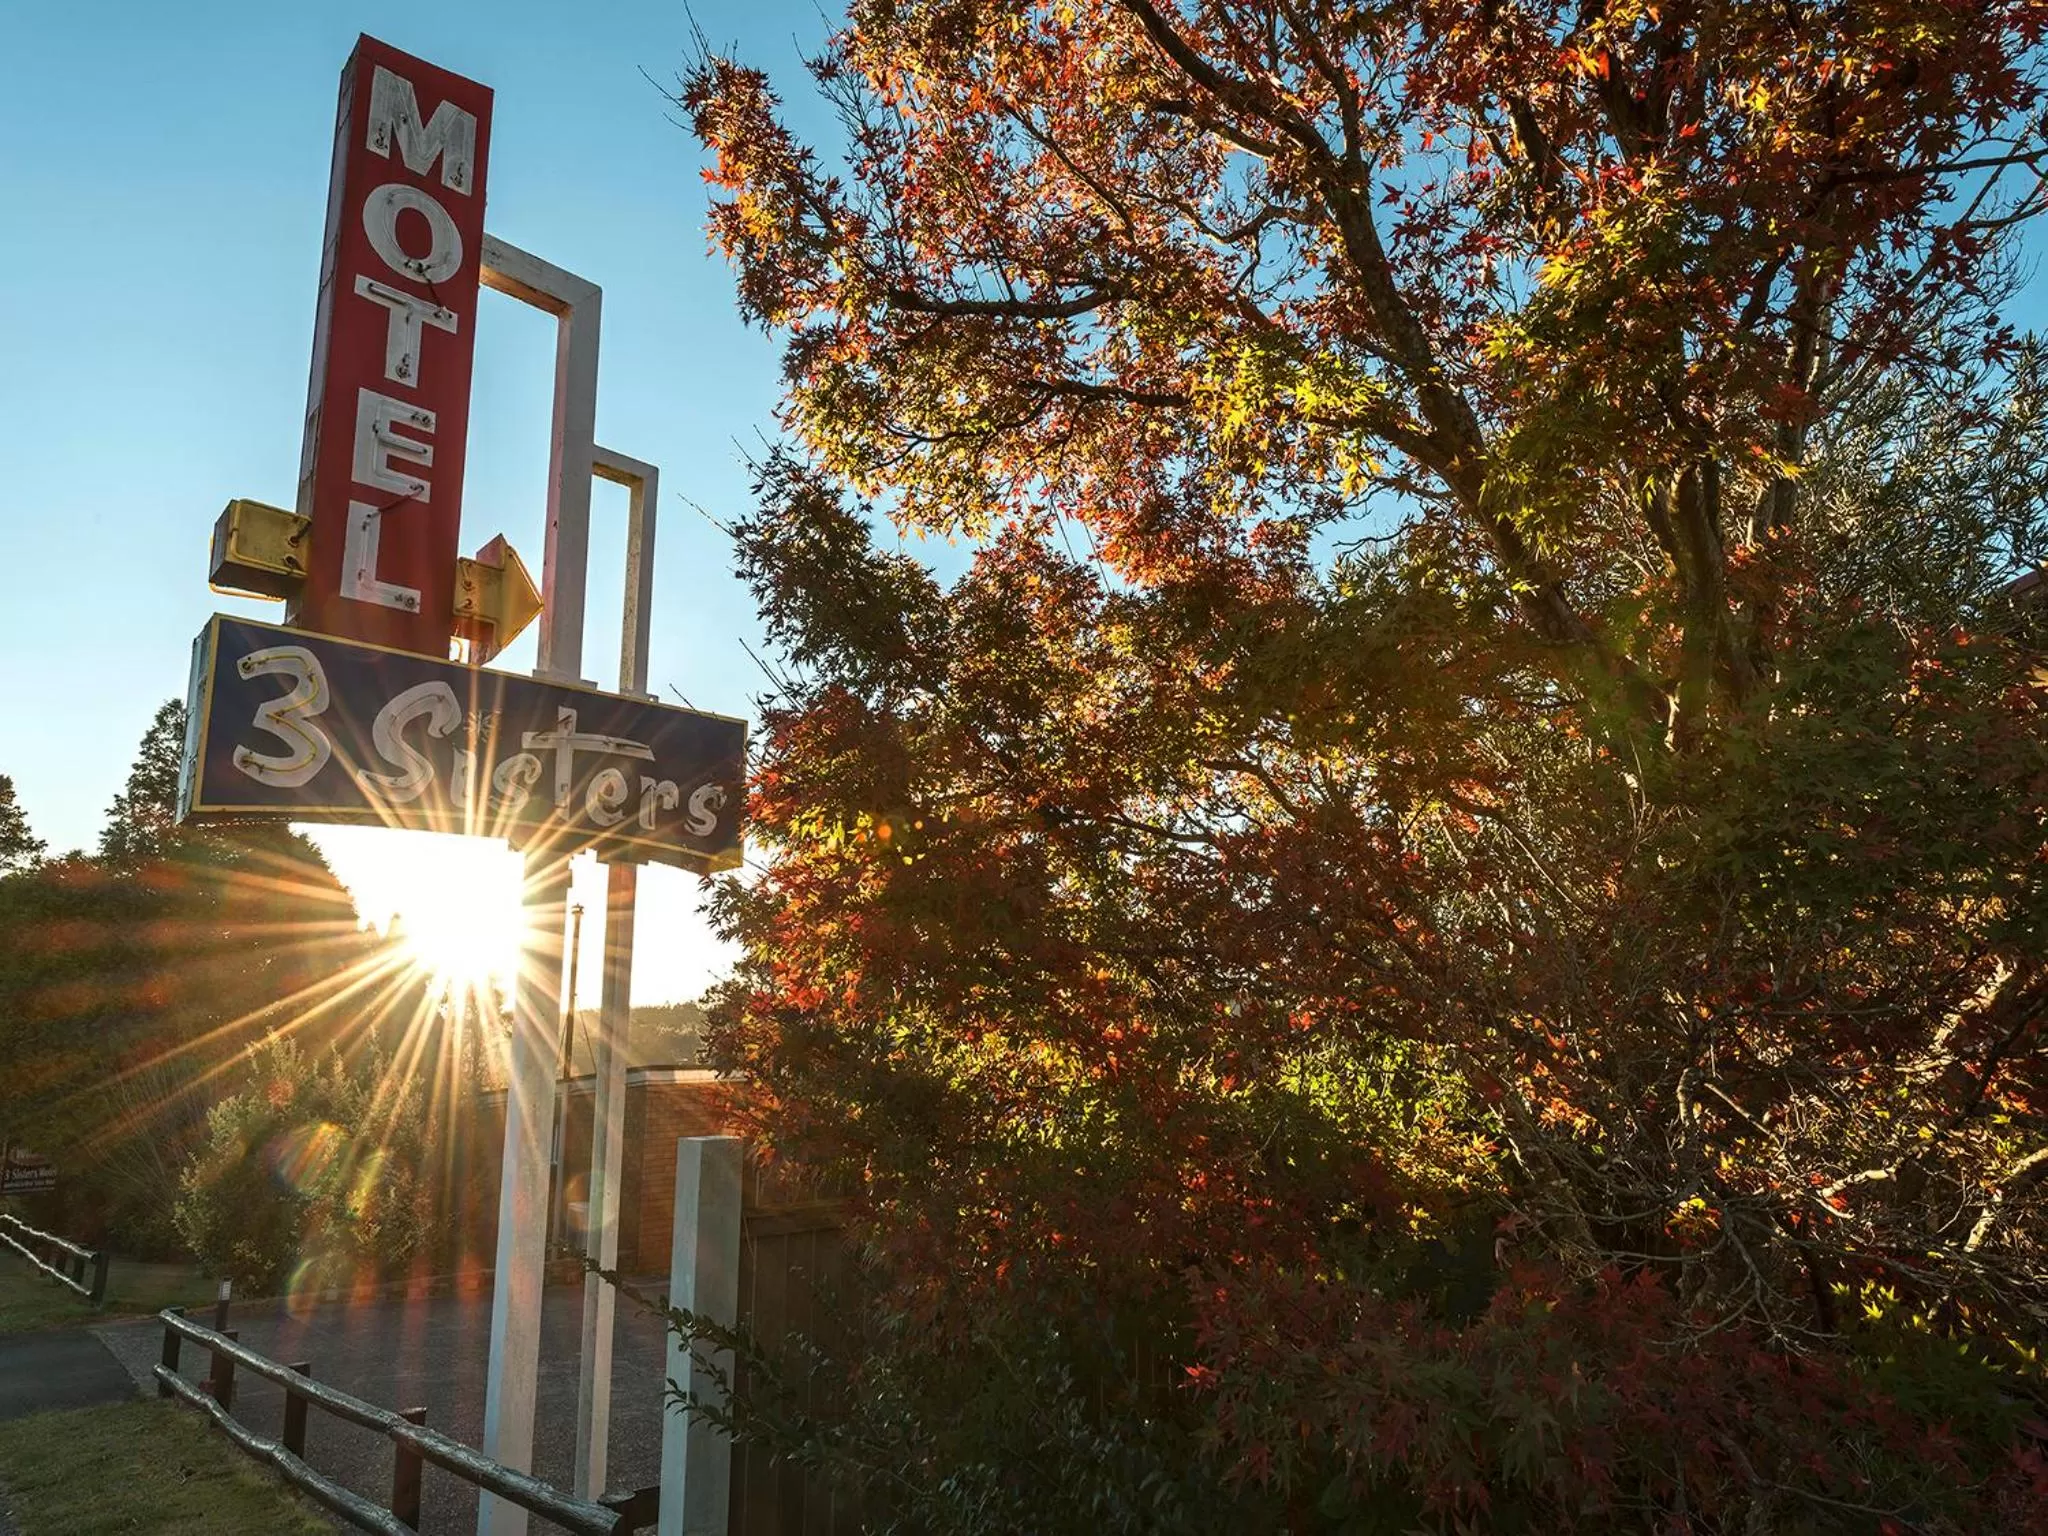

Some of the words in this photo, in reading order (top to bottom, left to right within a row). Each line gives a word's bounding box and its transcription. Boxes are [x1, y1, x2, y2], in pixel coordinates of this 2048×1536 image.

[338, 64, 478, 614] MOTEL
[232, 645, 332, 789] 3
[356, 680, 728, 837] Sisters
